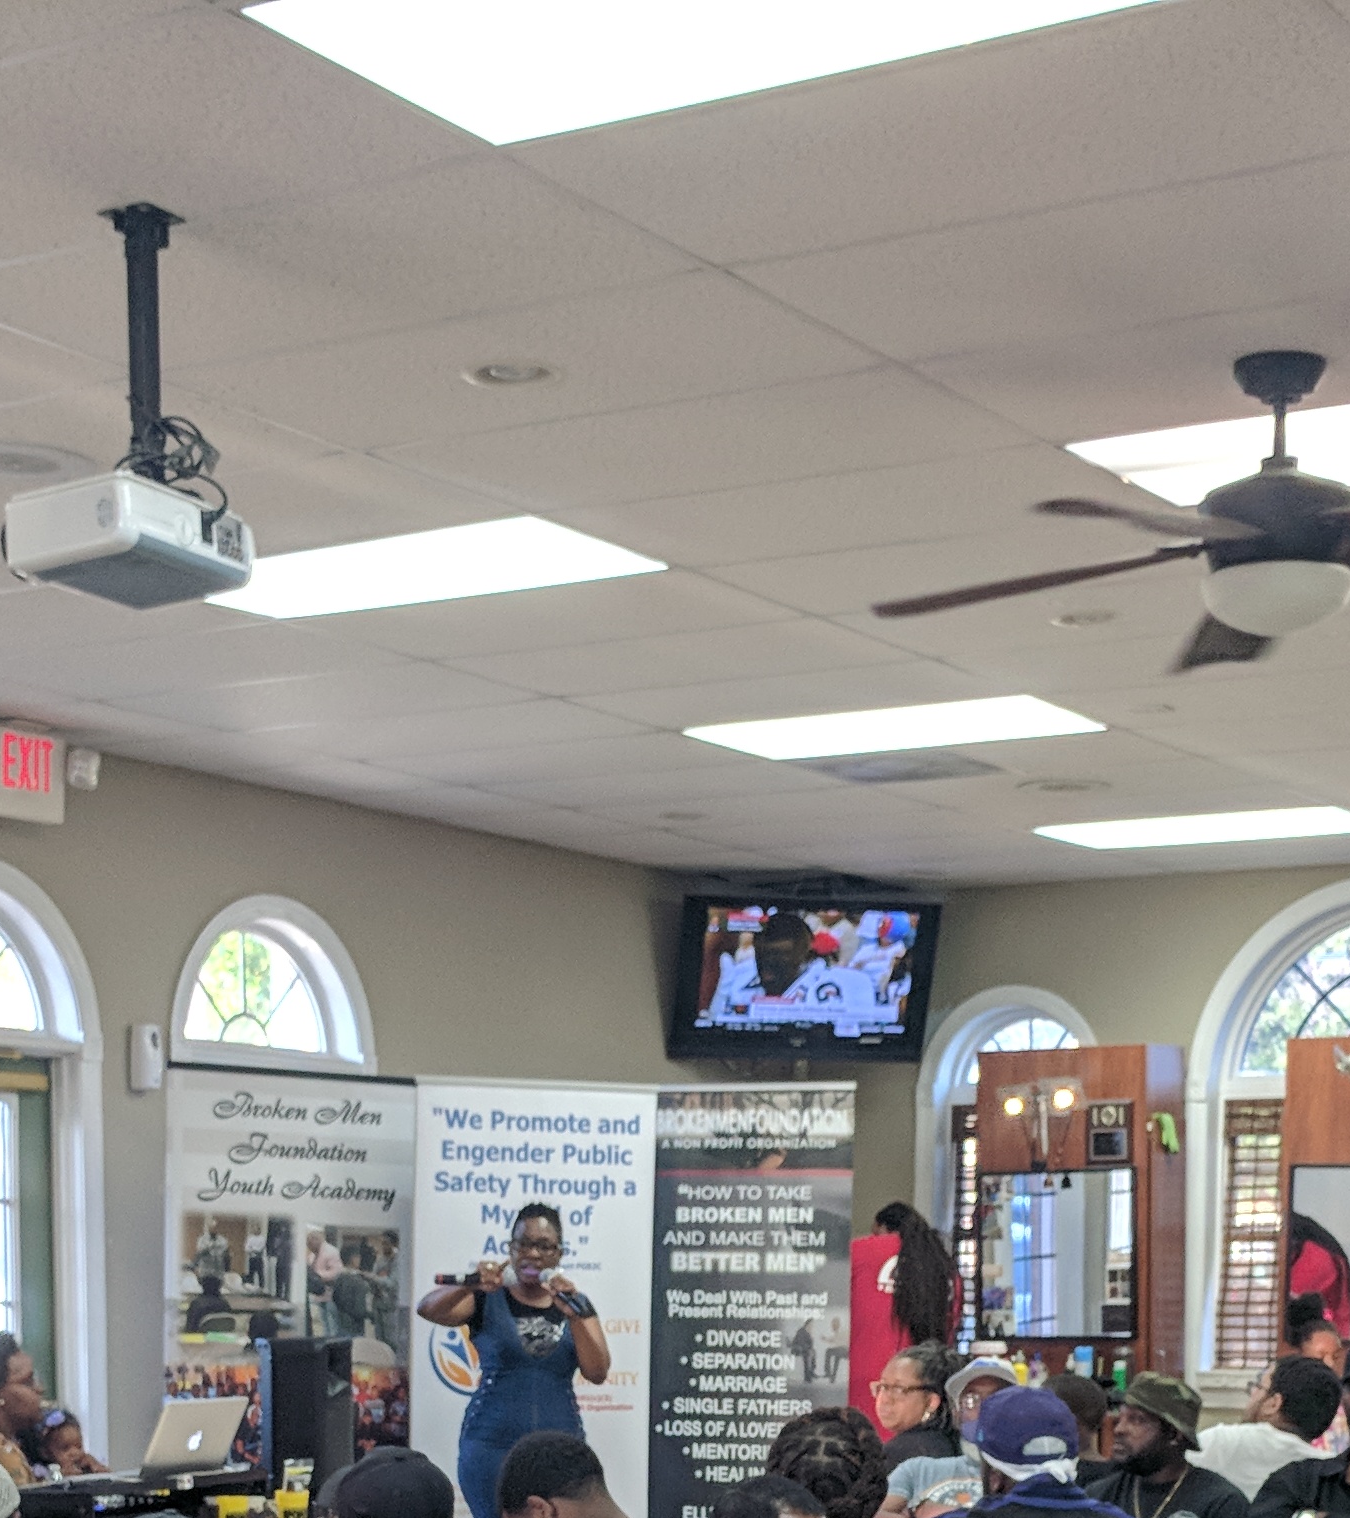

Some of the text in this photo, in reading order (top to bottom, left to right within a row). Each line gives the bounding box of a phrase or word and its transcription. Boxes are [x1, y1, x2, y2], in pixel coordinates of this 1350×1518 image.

[2, 732, 54, 794] EXIT
[213, 1091, 383, 1126] Broken Men
[433, 1107, 641, 1135] "We Promote and
[228, 1132, 368, 1165] Foundation
[704, 1138, 744, 1150] PROFIT
[746, 1137, 838, 1150] ORGANIZATION
[441, 1140, 633, 1166] Engender Public
[197, 1168, 396, 1212] Youth Academy
[434, 1171, 637, 1200] Safety Through a
[737, 1185, 762, 1200] TO
[766, 1184, 812, 1201] TAKE
[569, 1205, 594, 1226] of
[675, 1206, 814, 1224] BROKEN MEN
[662, 1230, 826, 1247] AND MAKE THEM
[670, 1251, 761, 1273] BETTER
[666, 1289, 828, 1306] We Deal With Past and
[668, 1304, 825, 1321] Present Relationships:
[706, 1330, 782, 1348] DIVORCE
[692, 1353, 796, 1371] SEPARATION
[699, 1375, 788, 1393] MARRIAGE
[673, 1398, 812, 1416] SINGLE FATHERS
[664, 1420, 702, 1437] LOSS
[705, 1421, 725, 1437] OF
[726, 1421, 738, 1438] A
